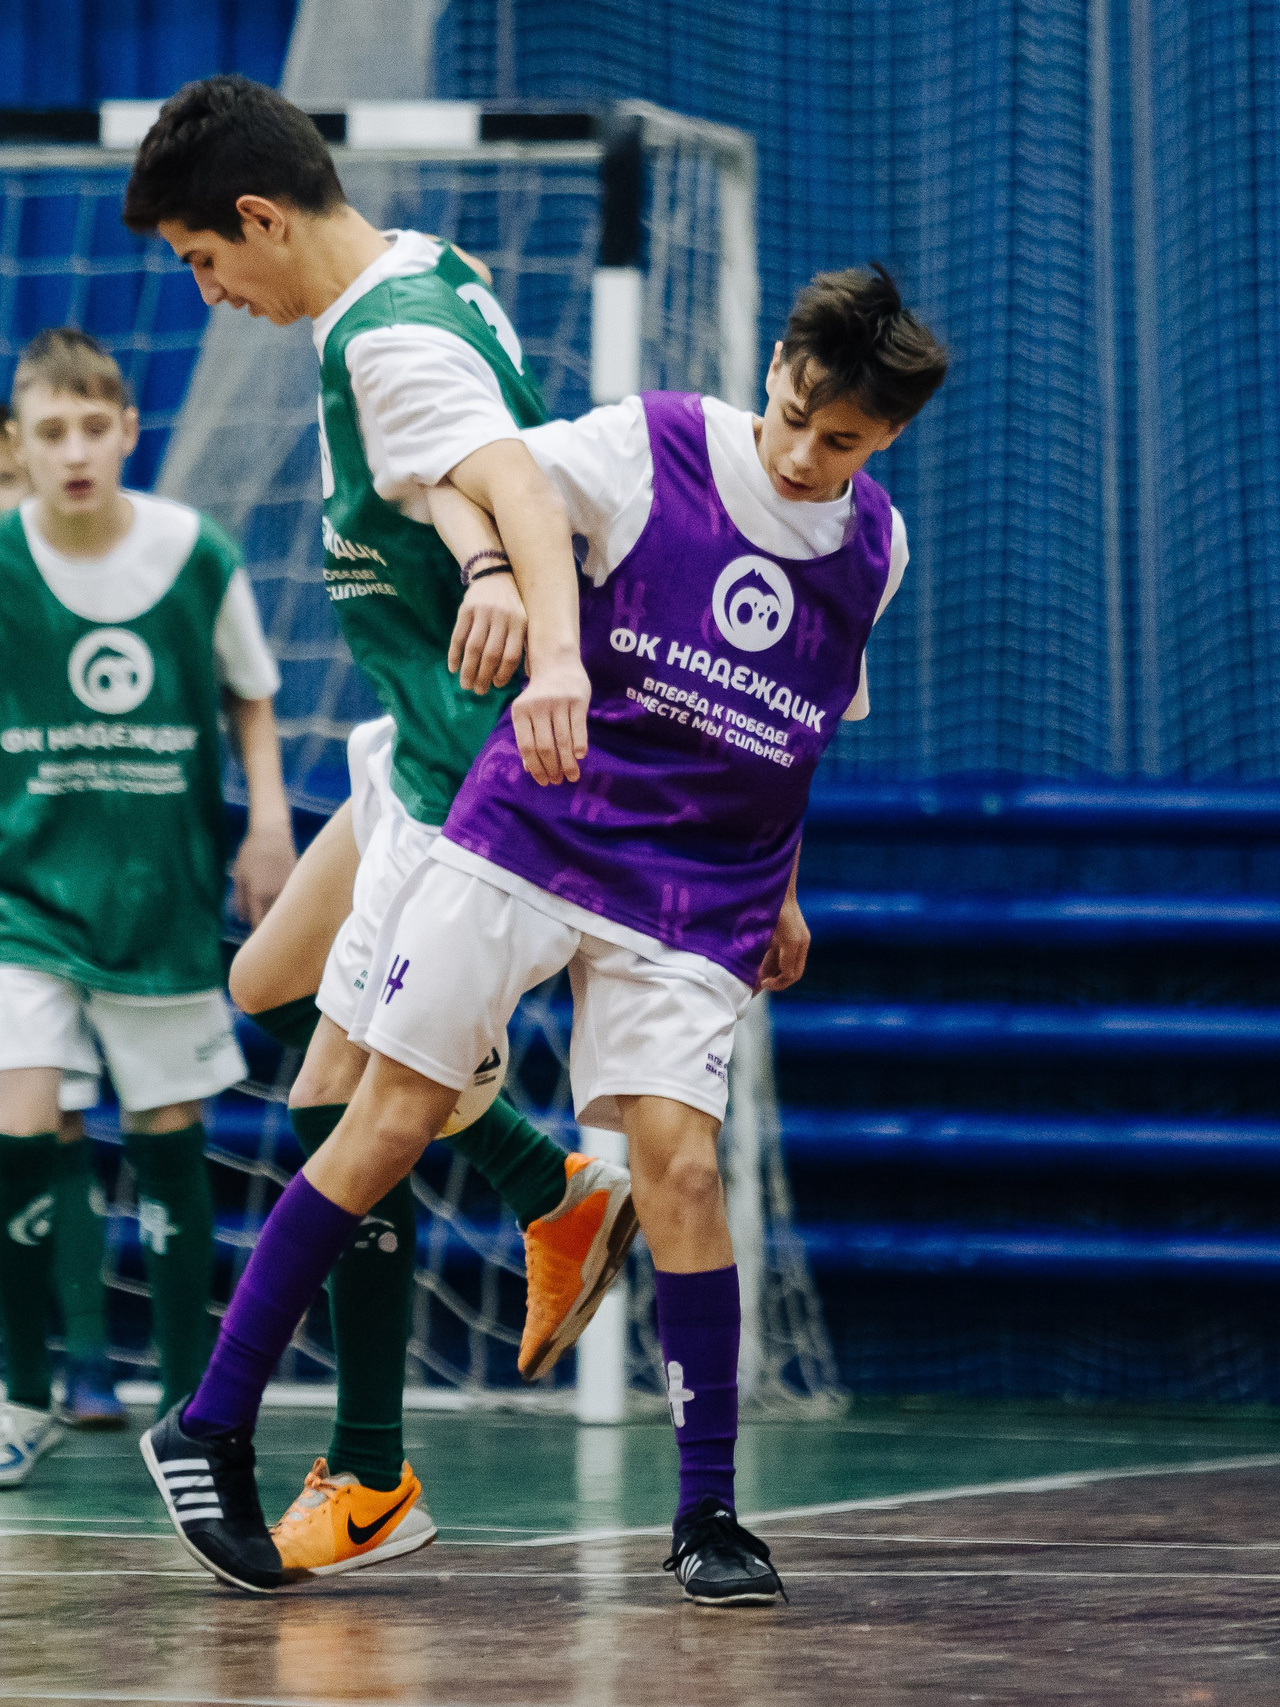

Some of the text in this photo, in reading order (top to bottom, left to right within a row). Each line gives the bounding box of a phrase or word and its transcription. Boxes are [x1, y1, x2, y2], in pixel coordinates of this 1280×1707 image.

[609, 628, 827, 733] ФК НАДЕЖДИК
[643, 677, 789, 747] ВПЕРЁД К ПОБЕДЕ!
[625, 687, 795, 768] ВМЕСТЕ МЫ СИЛЬНЕЕ!
